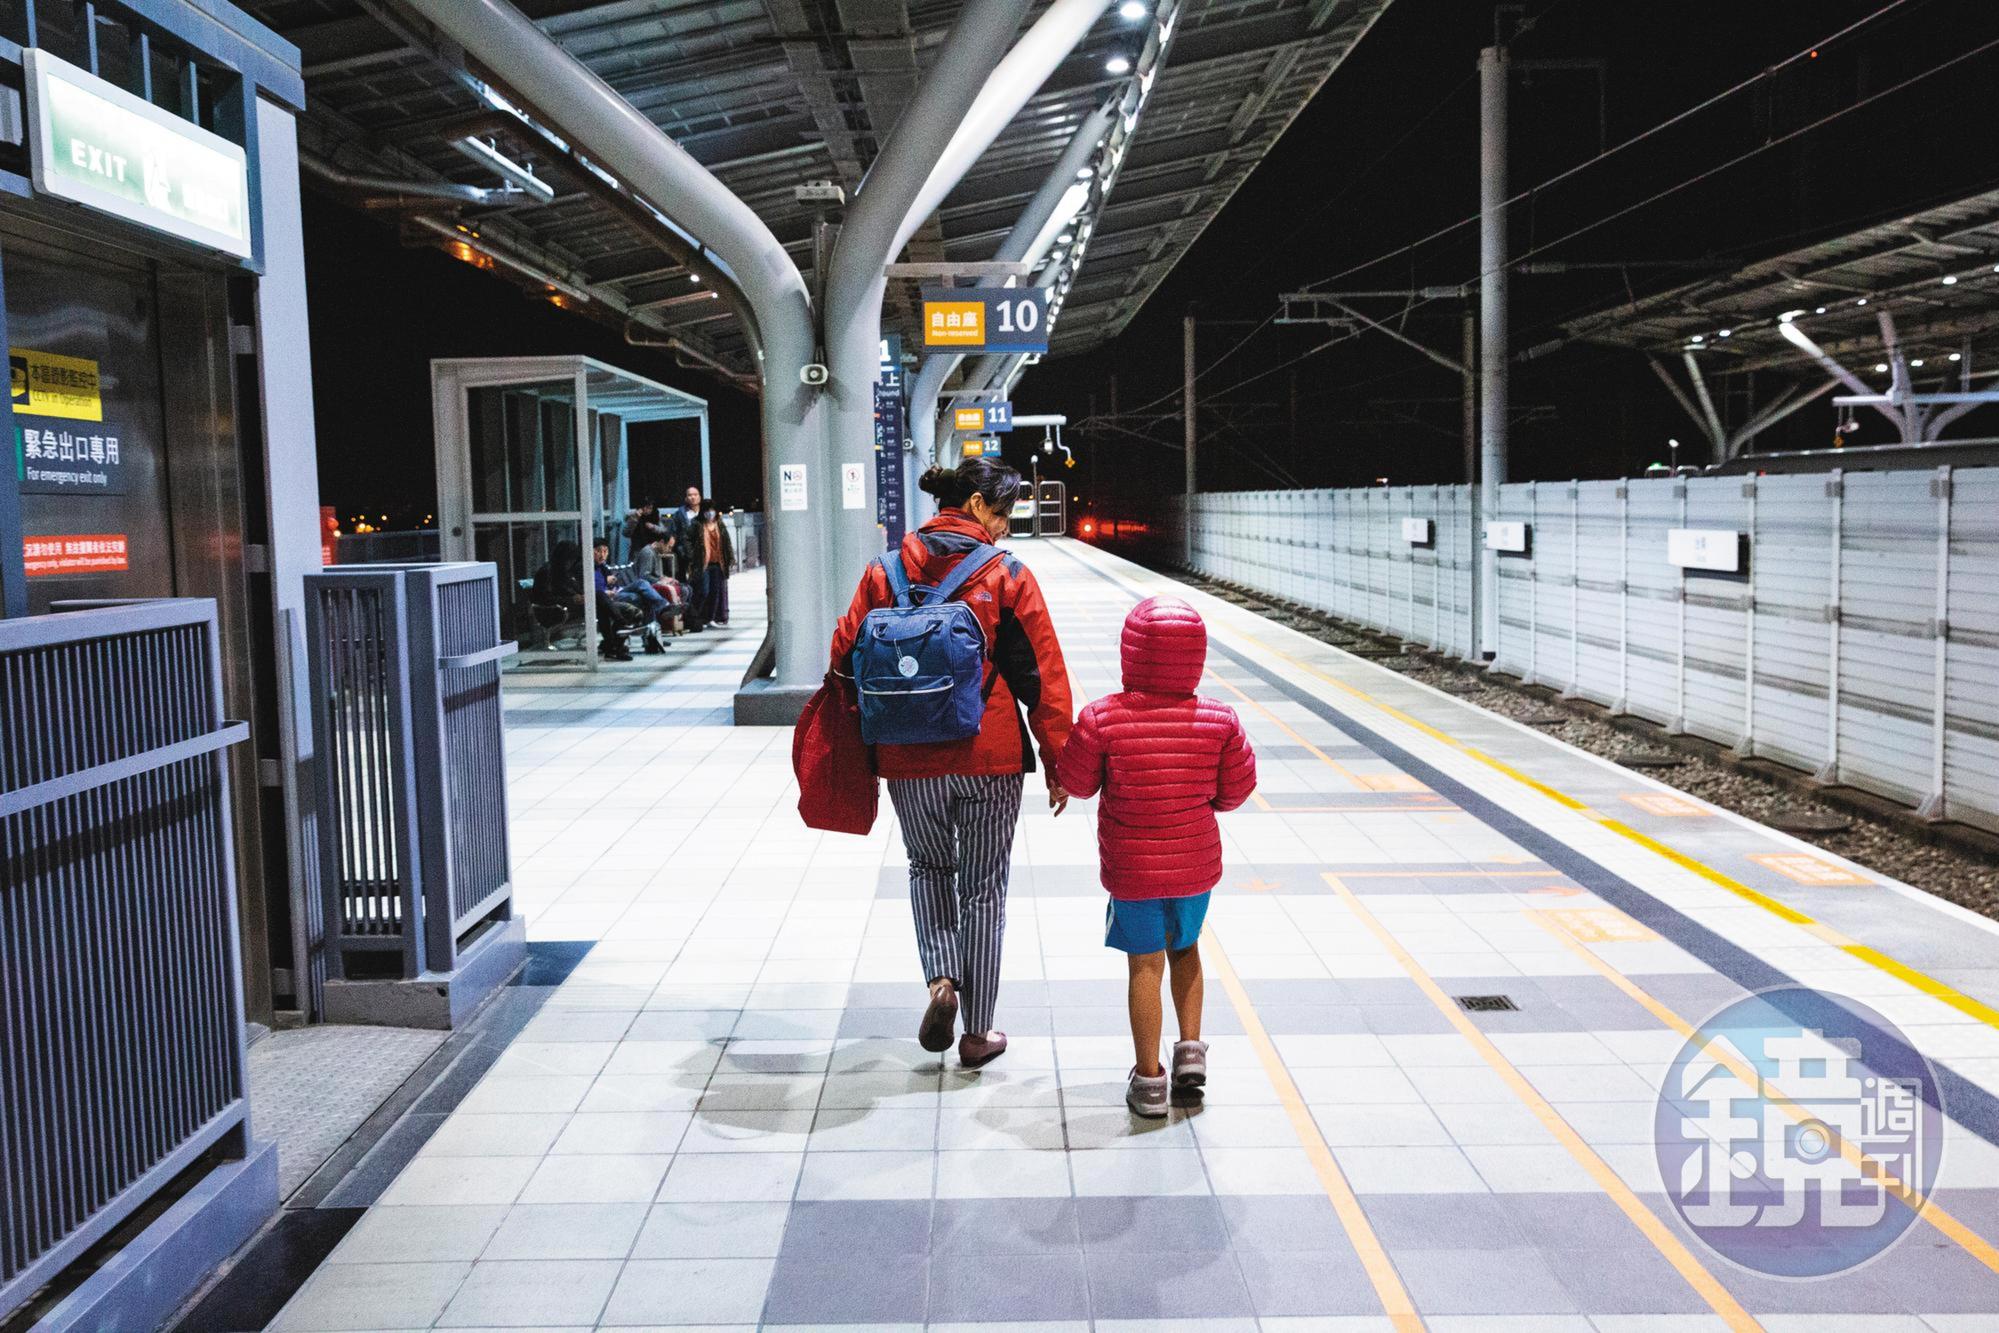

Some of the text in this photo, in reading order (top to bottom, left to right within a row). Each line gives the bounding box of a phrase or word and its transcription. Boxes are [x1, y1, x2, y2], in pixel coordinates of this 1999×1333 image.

[71, 138, 127, 182] EXIT
[931, 312, 978, 328] 自由座
[996, 299, 1039, 333] 10
[988, 407, 1007, 423] 11
[24, 429, 120, 465] 緊急出口專用
[984, 440, 998, 451] 12
[27, 466, 39, 480] For
[40, 470, 78, 485] emergency
